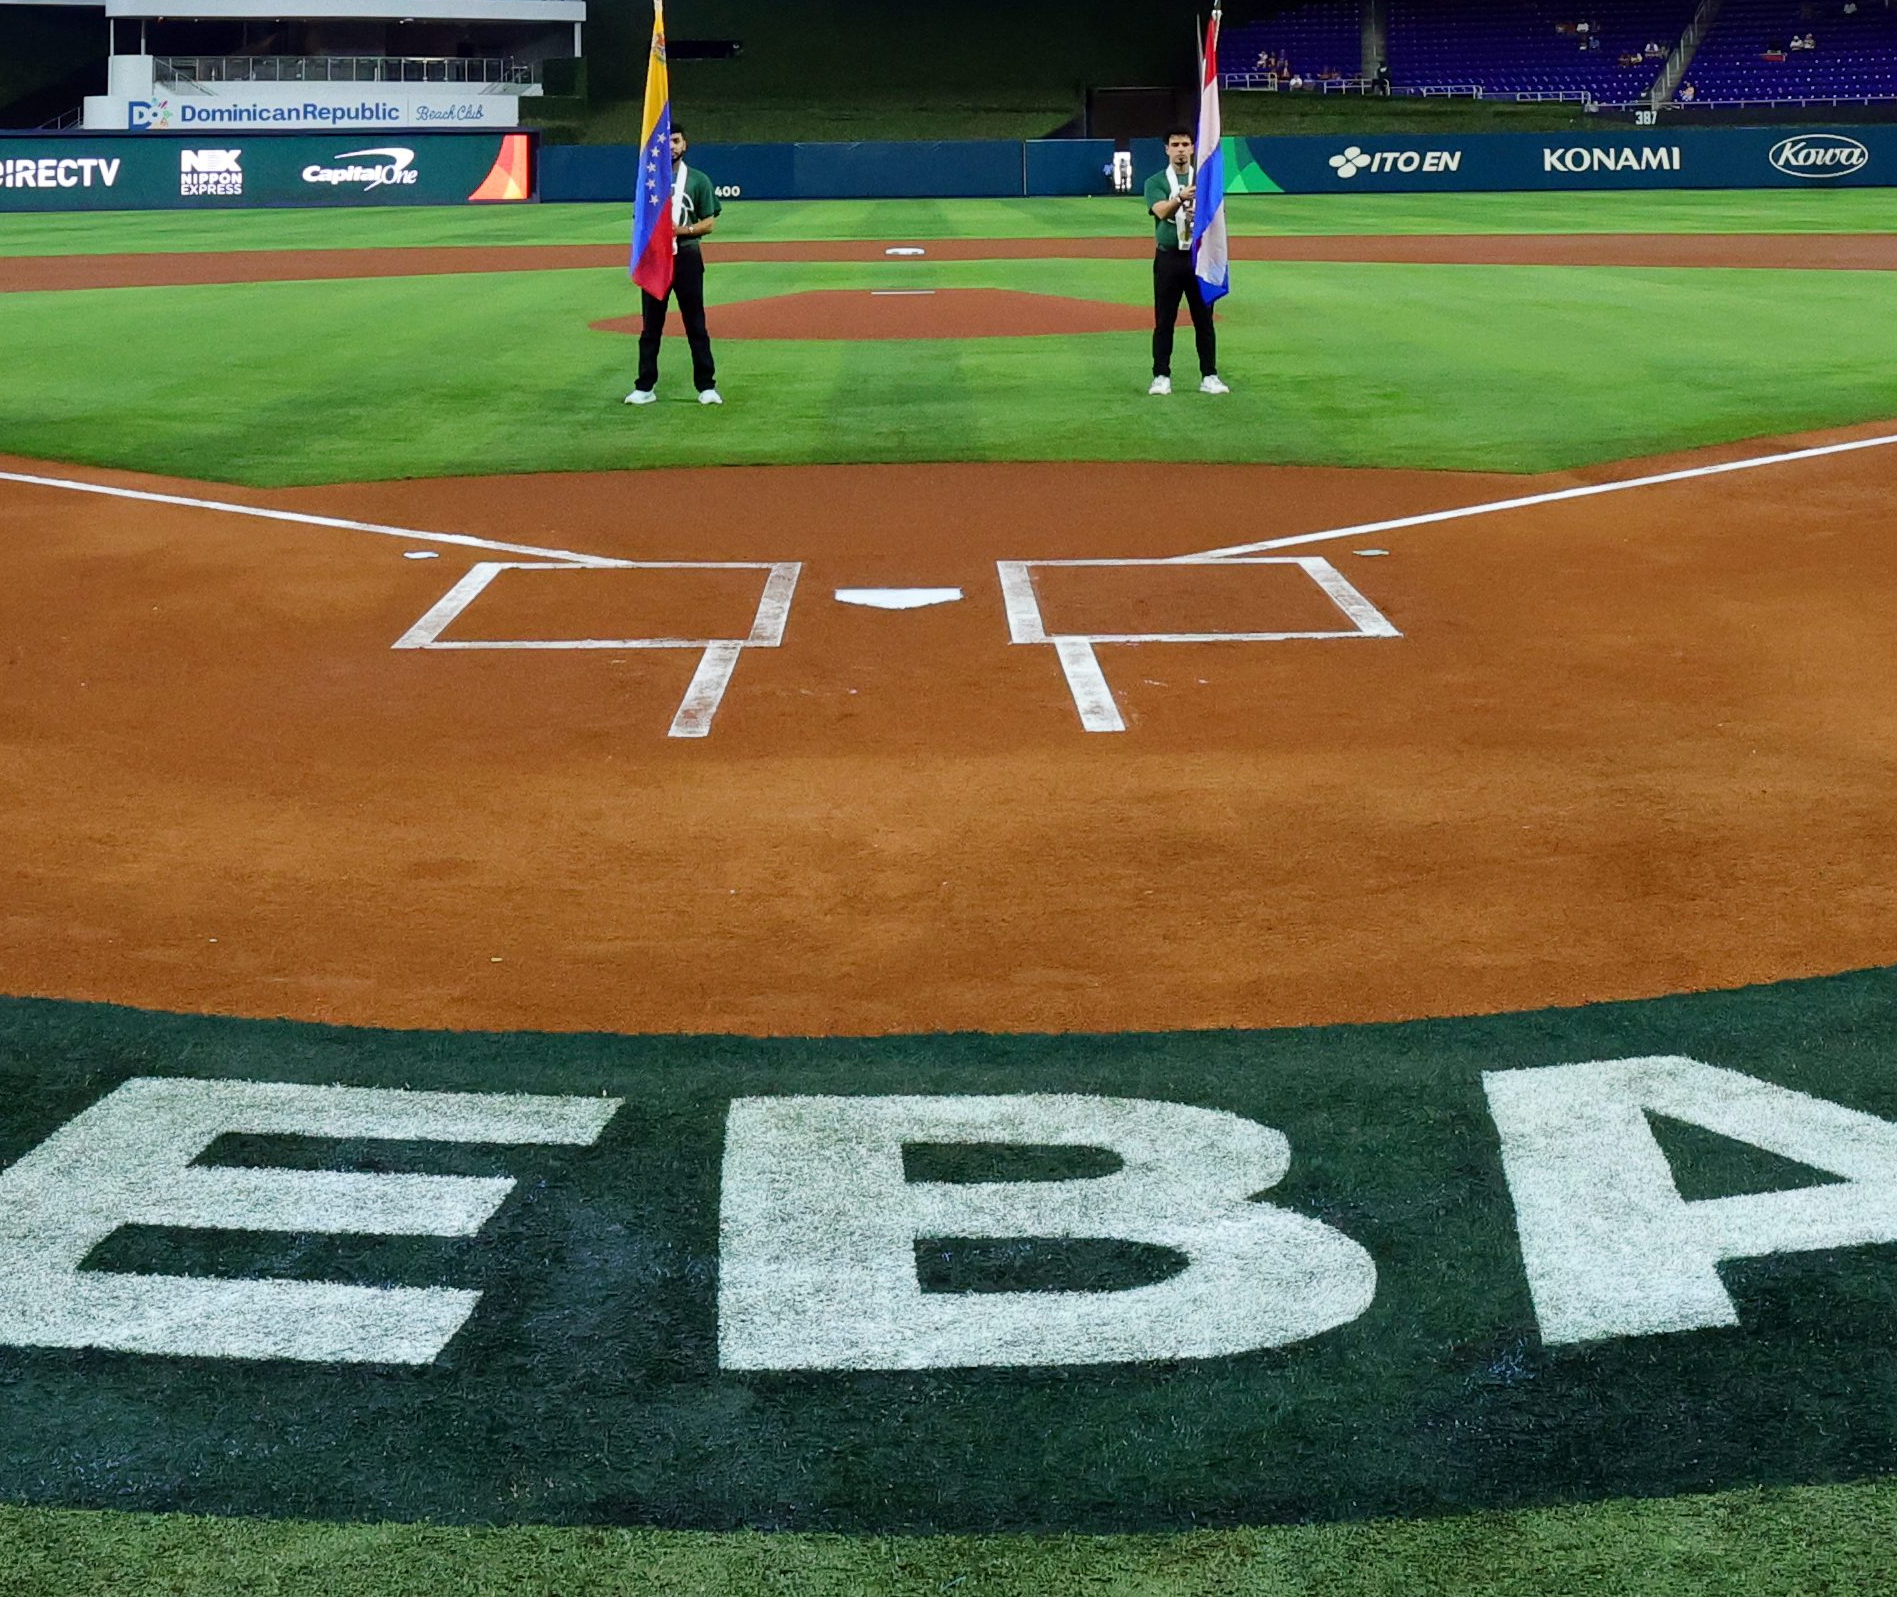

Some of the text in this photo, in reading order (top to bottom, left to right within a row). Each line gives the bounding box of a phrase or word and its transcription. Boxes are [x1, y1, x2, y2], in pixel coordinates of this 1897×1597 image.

[415, 105, 456, 122] Beach
[456, 105, 485, 121] Club
[1635, 111, 1658, 126] 387
[1542, 146, 1681, 172] KONAMI
[1777, 141, 1864, 166] Kowa
[180, 172, 242, 185] NIPPON
[180, 184, 242, 196] EXPRESS
[714, 185, 741, 198] 400
